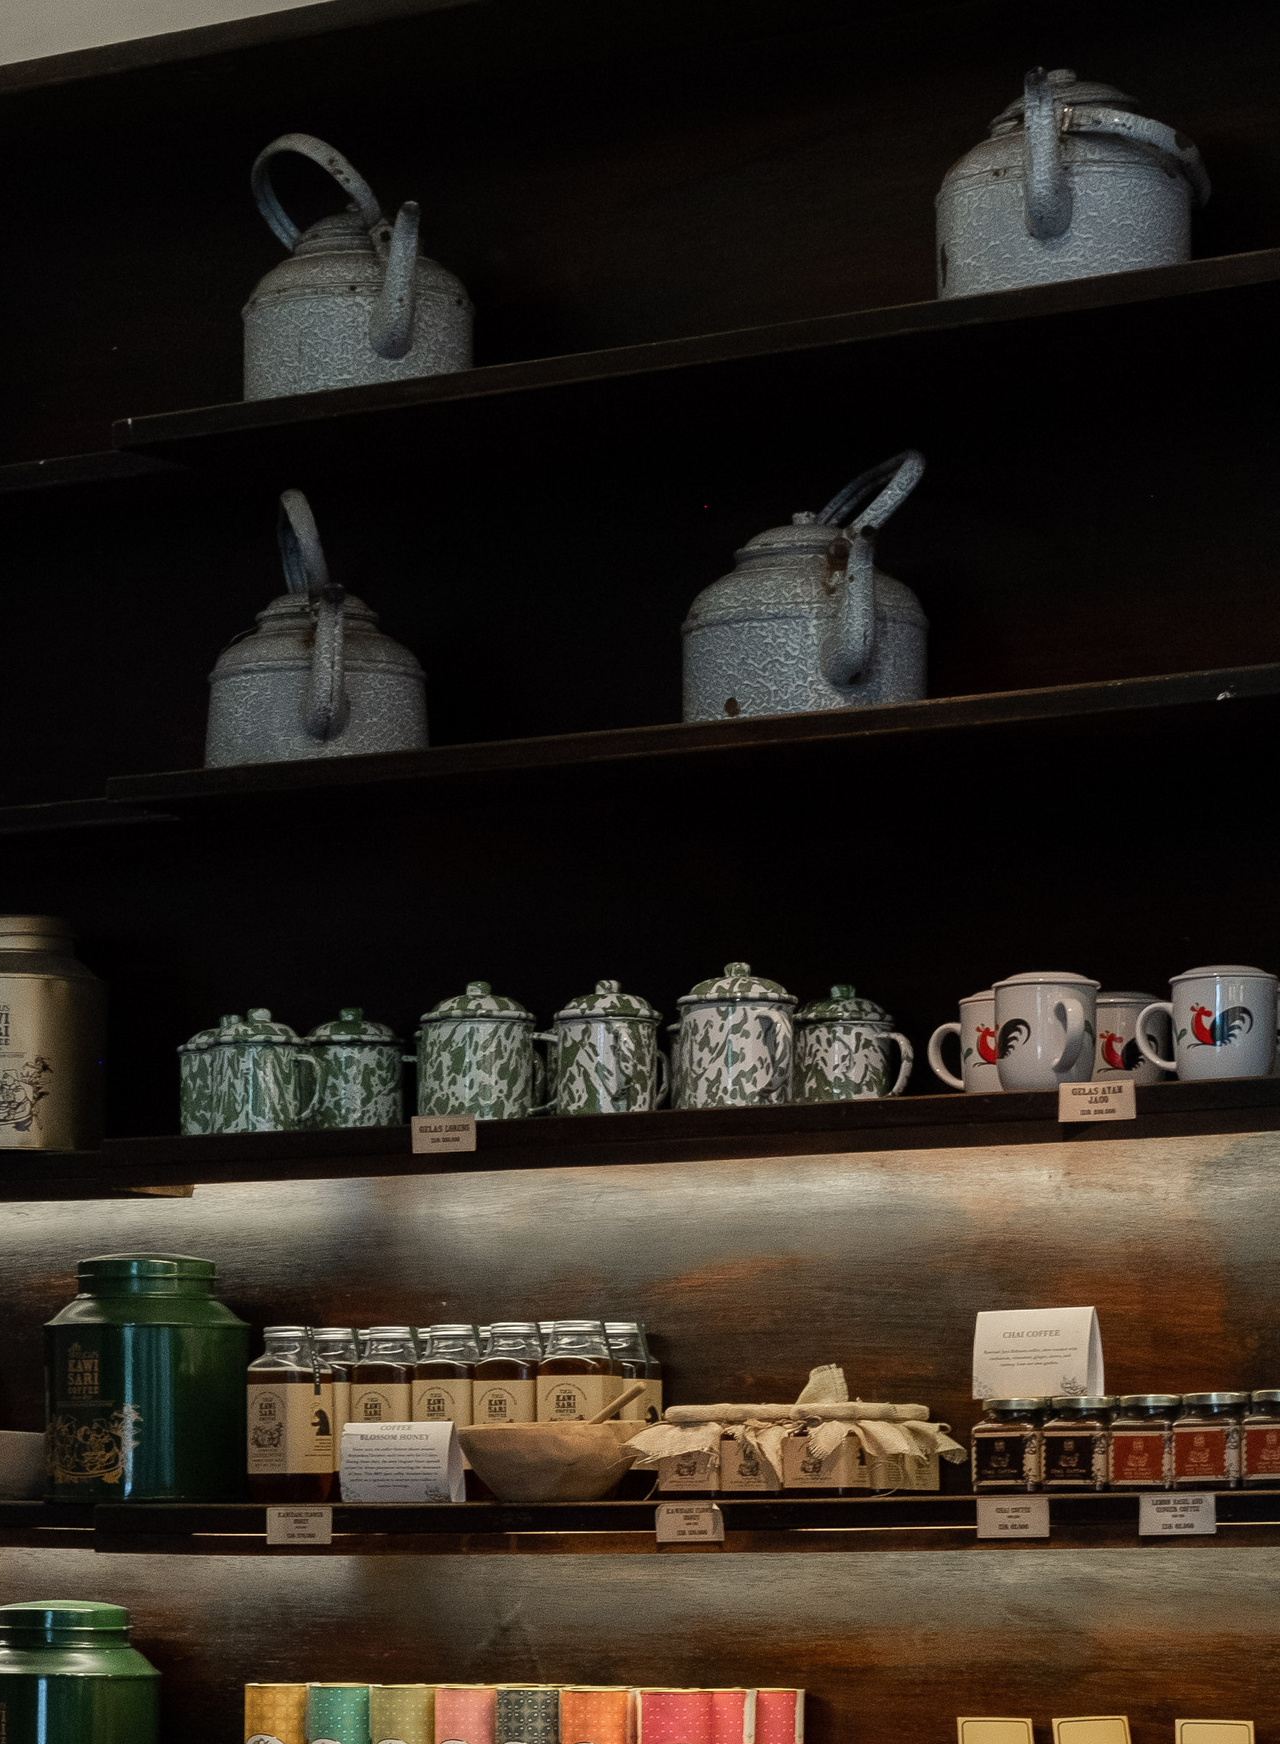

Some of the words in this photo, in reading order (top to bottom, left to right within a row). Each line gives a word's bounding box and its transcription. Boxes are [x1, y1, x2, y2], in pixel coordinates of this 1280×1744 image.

[1071, 1087, 1099, 1096] GELAS
[1026, 1329, 1061, 1337] COFFEE
[68, 1359, 100, 1372] KAWI
[67, 1372, 100, 1386] SARI
